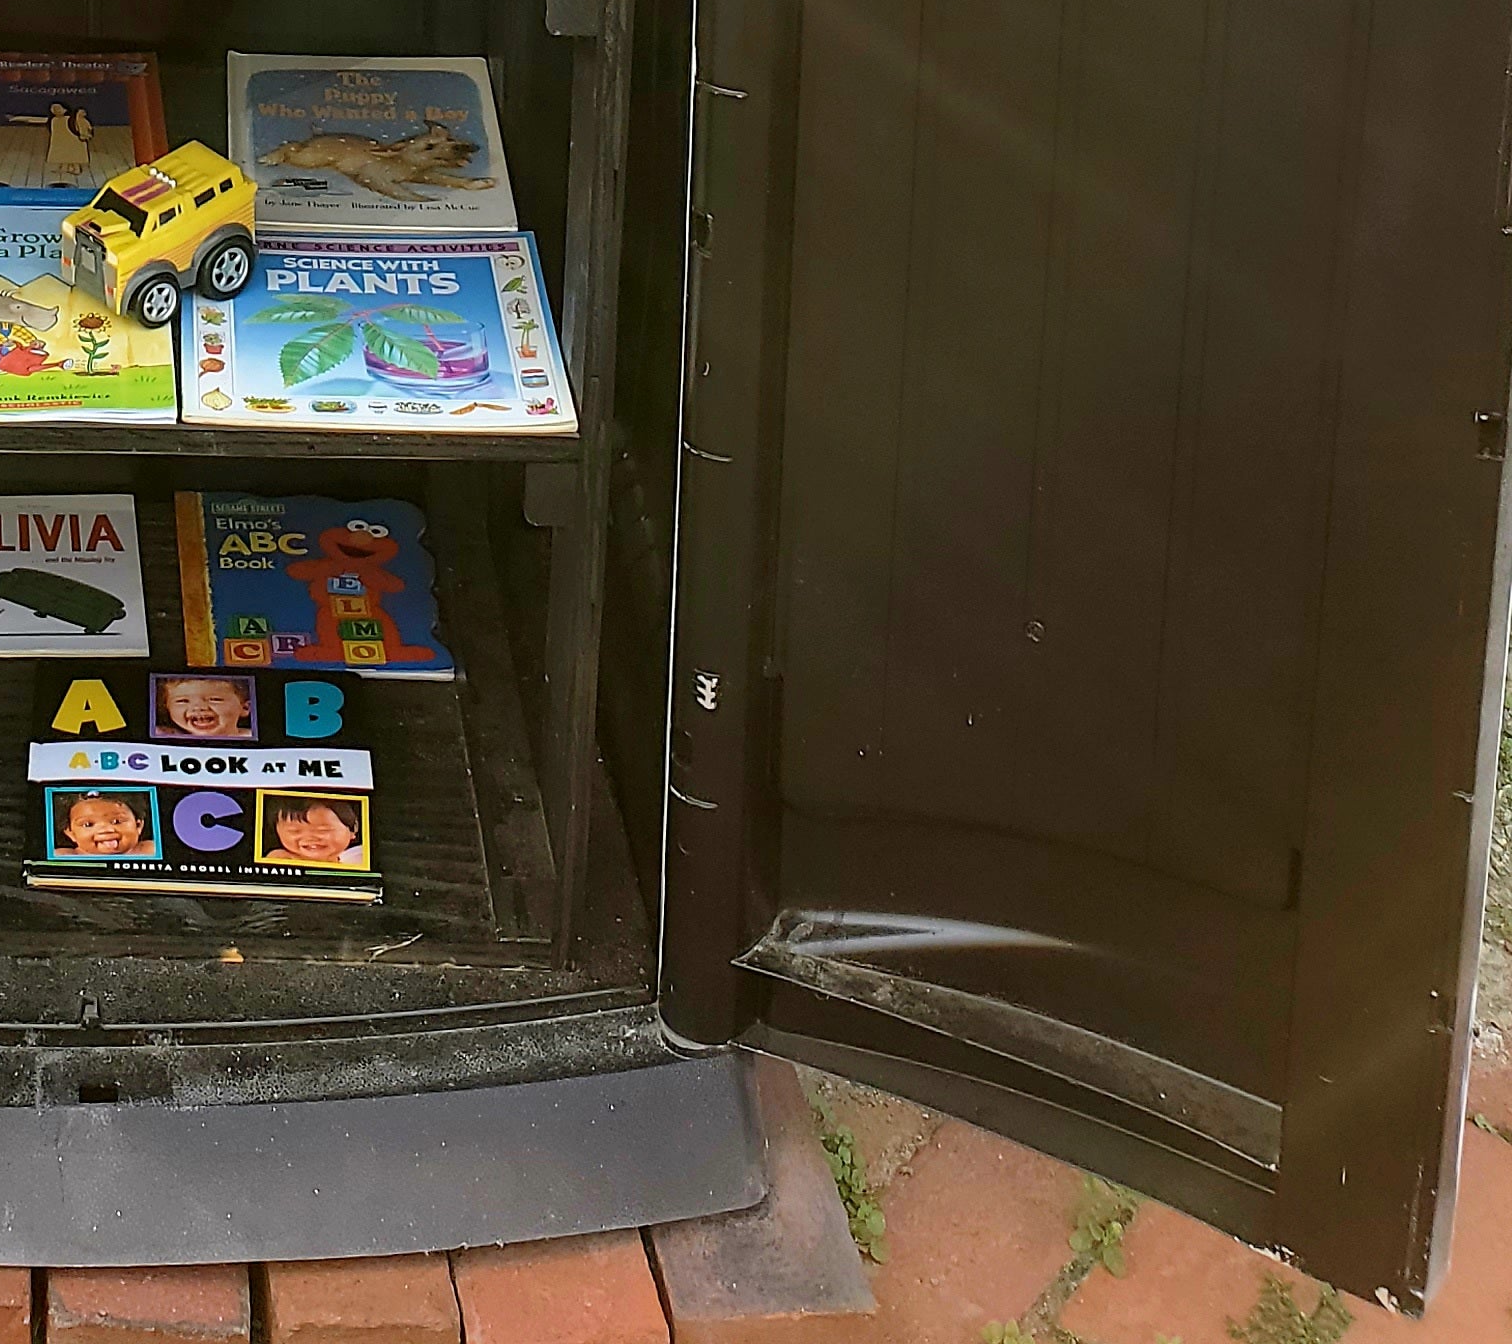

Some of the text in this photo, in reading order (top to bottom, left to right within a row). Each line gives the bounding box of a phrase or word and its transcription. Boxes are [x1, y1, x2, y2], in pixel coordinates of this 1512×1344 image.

[337, 72, 382, 85] The
[9, 84, 96, 95] Sacagawea
[325, 88, 398, 105] Puppy
[258, 104, 305, 118] Who
[18, 245, 62, 259] Pla
[314, 243, 506, 252] SCIENCE ACTIVITIES
[284, 258, 440, 271] SCIENCE WITH
[266, 269, 460, 295] PLANTS
[216, 518, 282, 530] Elmo's
[219, 532, 308, 555] ABC
[219, 557, 275, 569] Book
[51, 679, 344, 739] A B
[161, 754, 249, 774] LOOK
[262, 761, 287, 773] AT
[297, 760, 343, 778] ME
[173, 791, 244, 852] C
